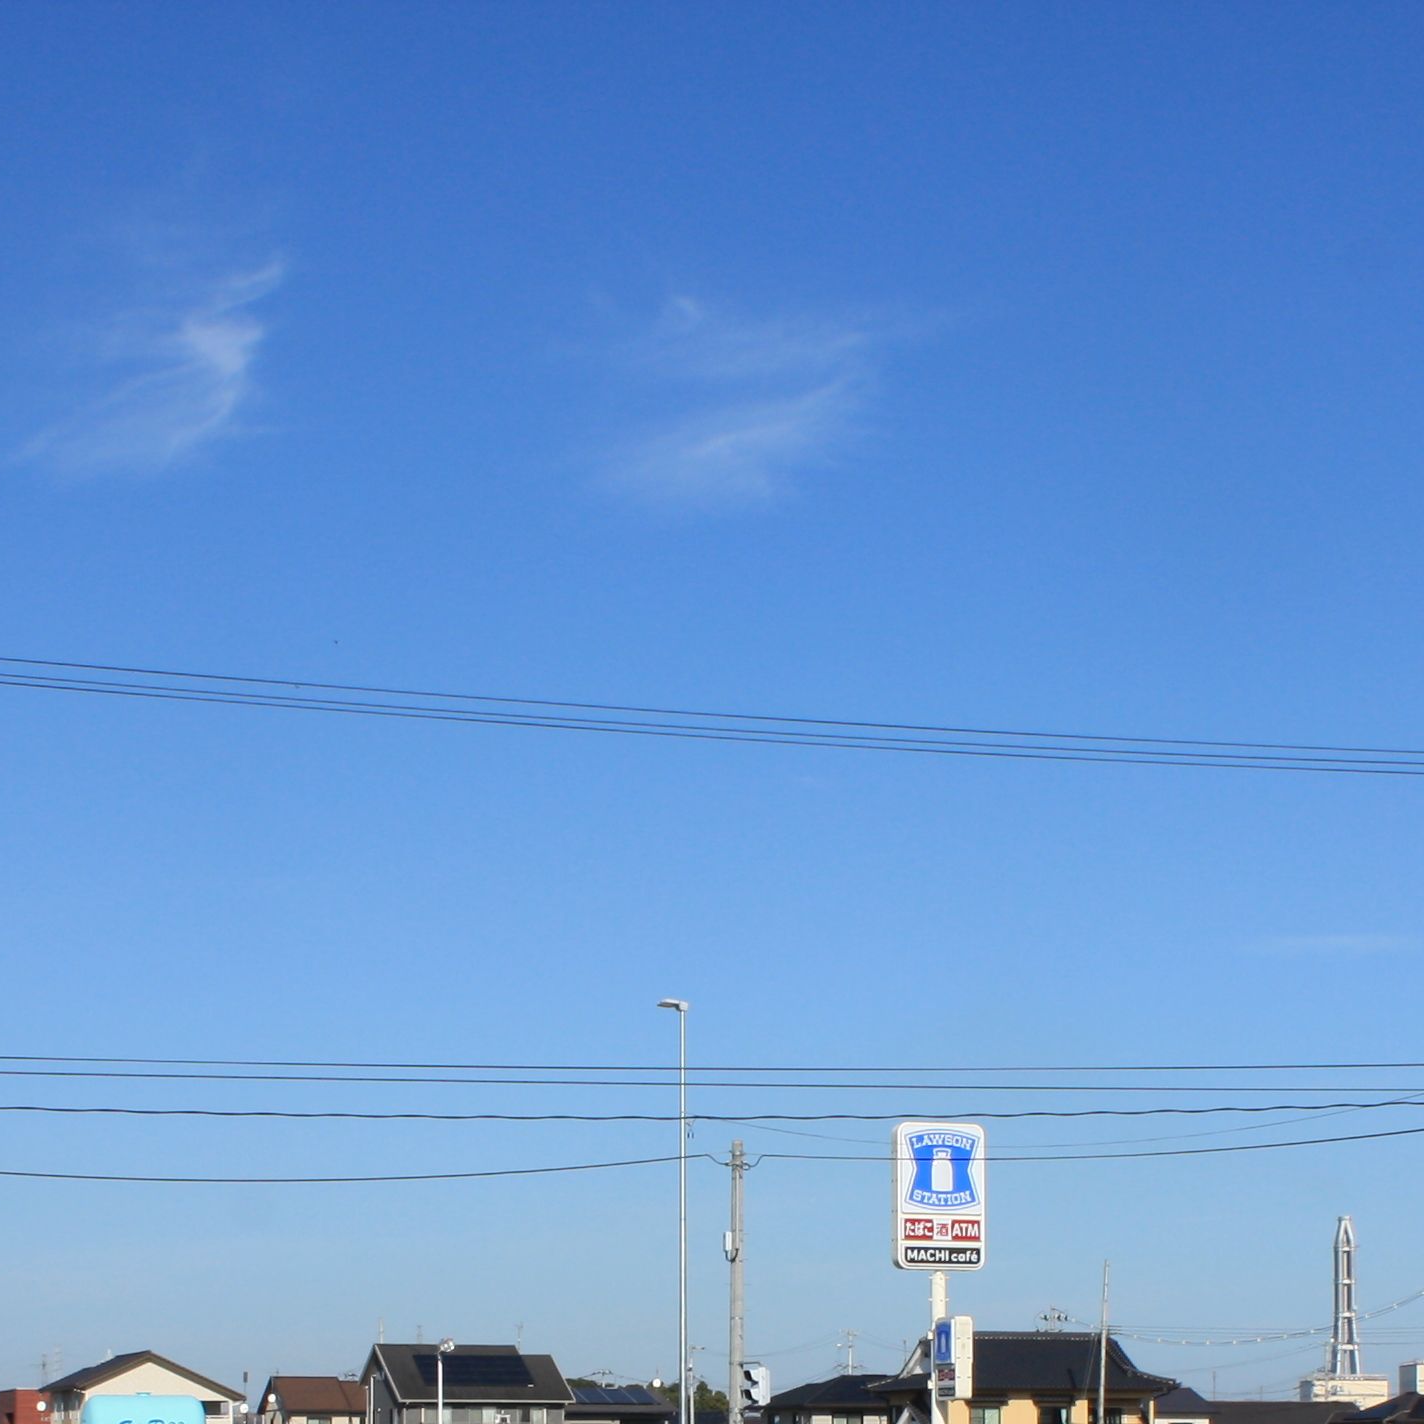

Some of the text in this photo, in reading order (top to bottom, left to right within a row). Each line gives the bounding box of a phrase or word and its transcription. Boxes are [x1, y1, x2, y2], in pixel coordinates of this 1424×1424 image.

[912, 1133, 972, 1150] LAWSON
[912, 1190, 972, 1205] STATION
[905, 1222, 933, 1236] たばこ
[952, 1223, 979, 1237] ATM
[906, 1249, 978, 1262] MACHI café
